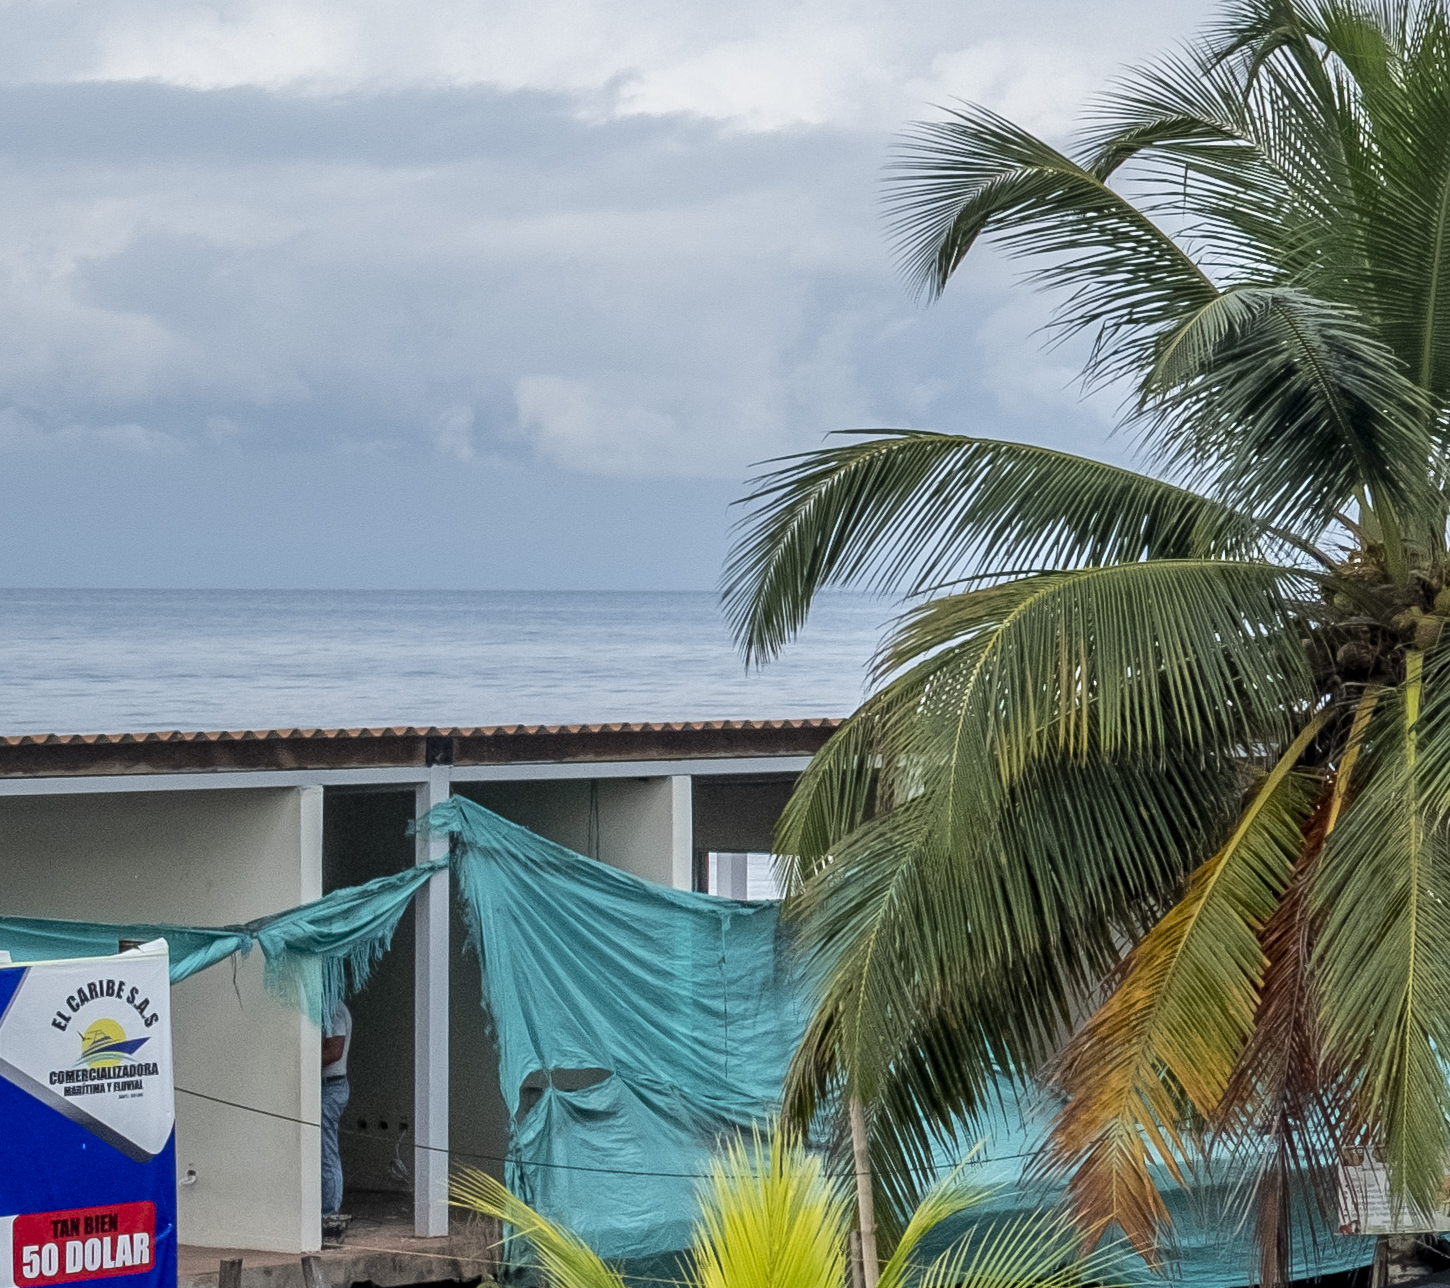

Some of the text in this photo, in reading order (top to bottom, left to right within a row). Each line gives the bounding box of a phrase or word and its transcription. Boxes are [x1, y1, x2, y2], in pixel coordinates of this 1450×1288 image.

[51, 978, 160, 1032] EL CARIBE S.A.S
[49, 1062, 160, 1085] COMERCIALIZADORA
[106, 1082, 113, 1092] Y
[52, 1213, 118, 1239] TAN BIEN
[22, 1232, 150, 1279] 50 DOLAR
